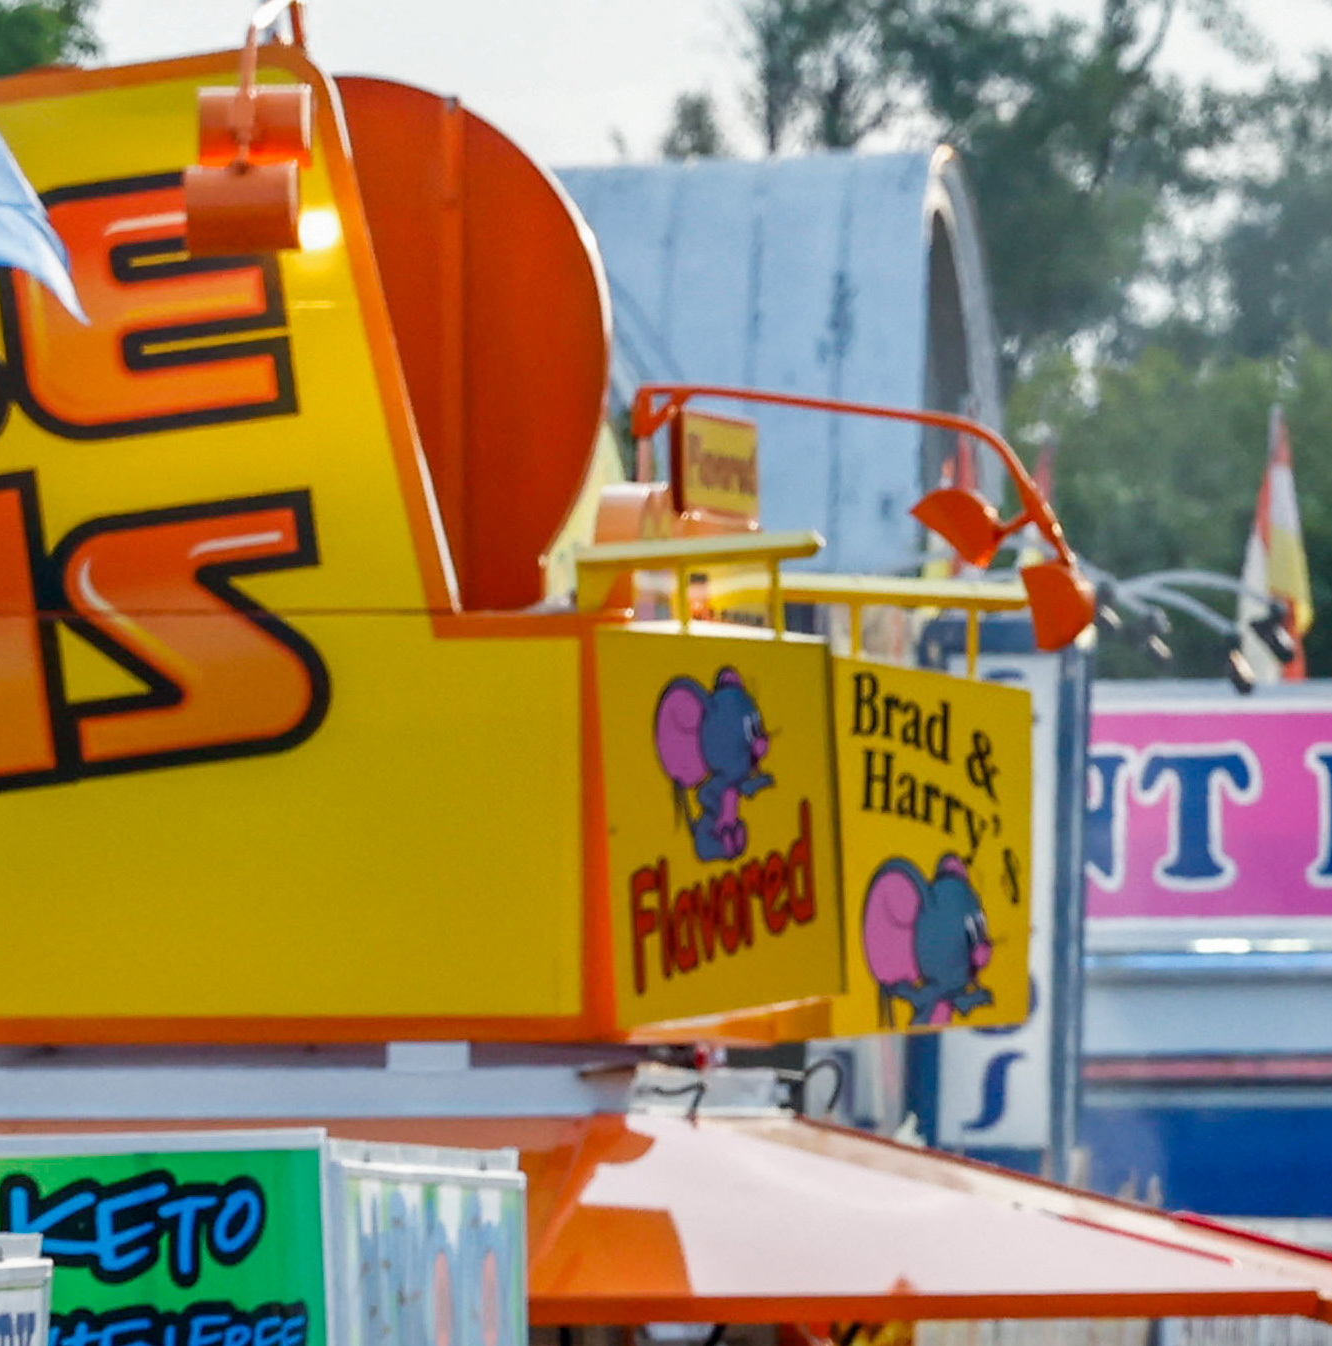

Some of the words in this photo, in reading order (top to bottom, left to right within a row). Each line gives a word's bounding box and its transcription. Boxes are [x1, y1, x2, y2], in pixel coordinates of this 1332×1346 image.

[852, 670, 953, 764] Brad
[966, 730, 1001, 803] &
[630, 797, 817, 998] Flavored
[860, 747, 1023, 905] Harry's
[0, 1170, 267, 1287] KETO
